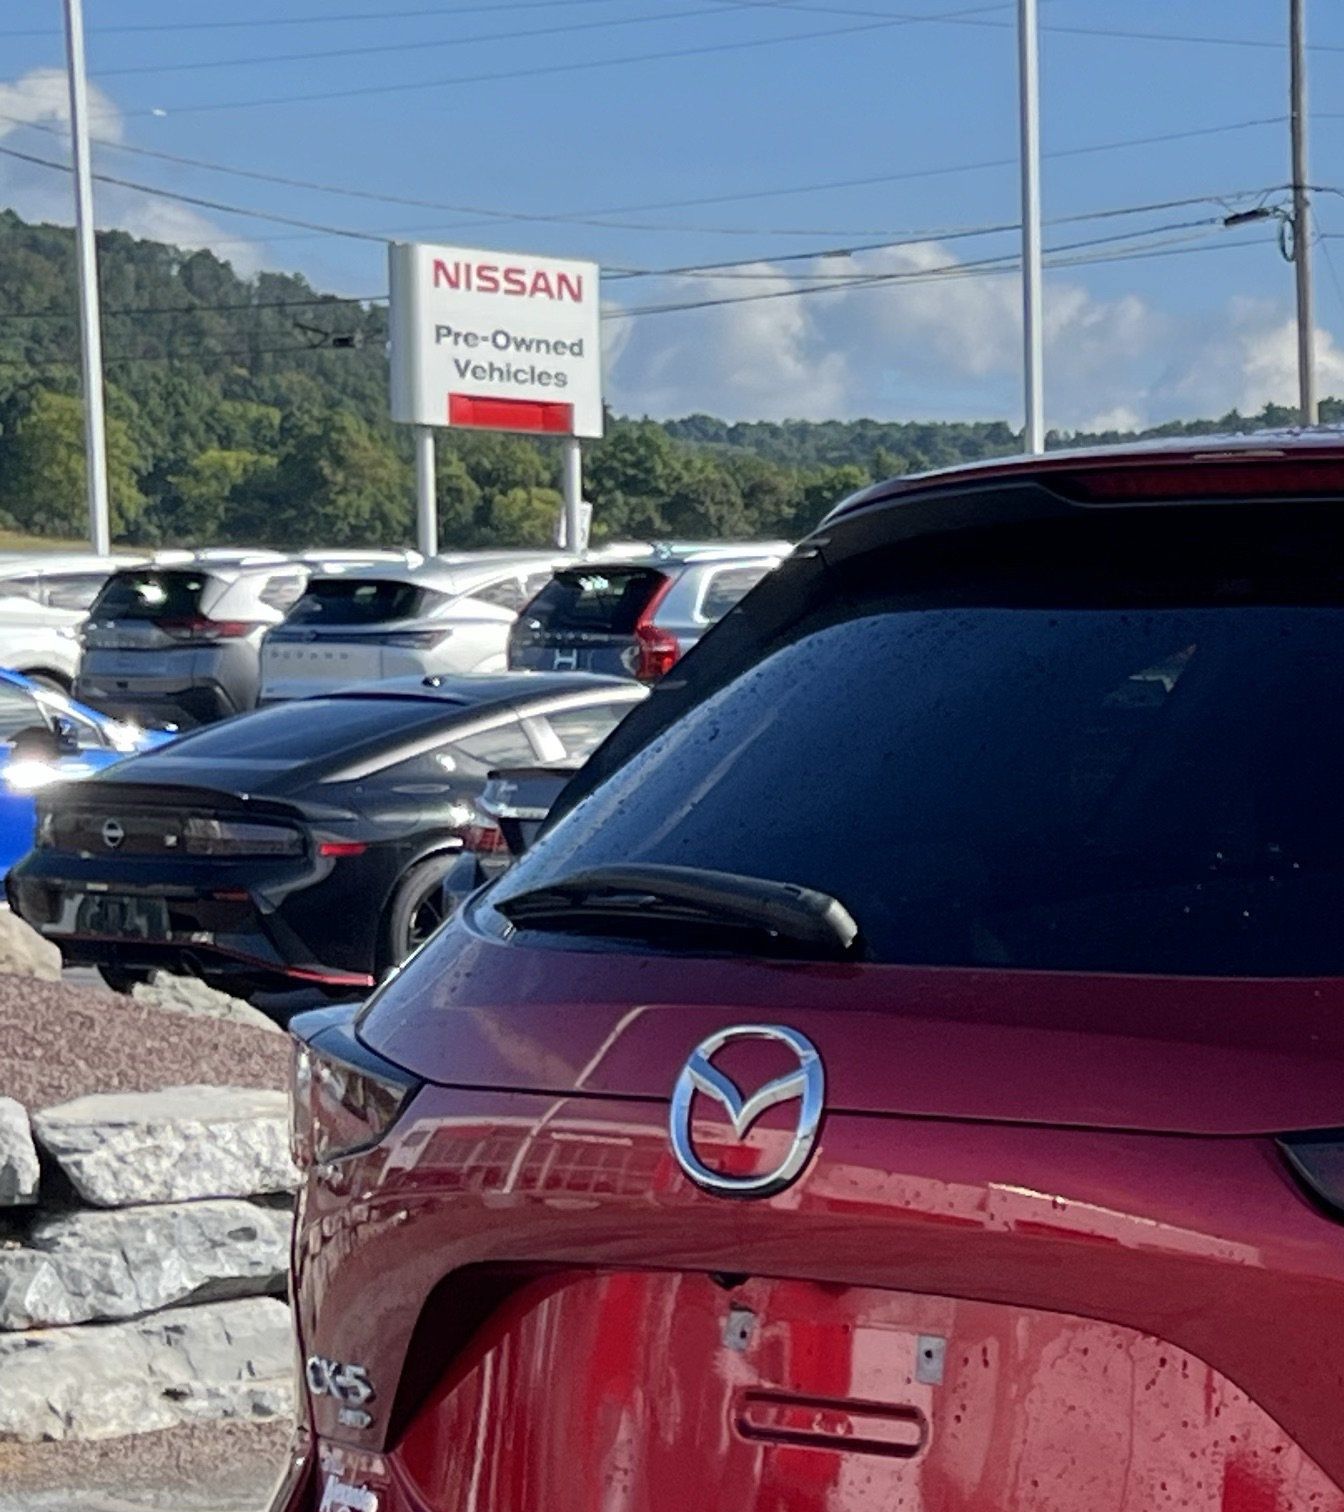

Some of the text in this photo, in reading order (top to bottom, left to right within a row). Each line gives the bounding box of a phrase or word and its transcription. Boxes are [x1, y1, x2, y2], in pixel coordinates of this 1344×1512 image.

[433, 258, 584, 304] NISSAN
[434, 324, 585, 358] Pre-Owned
[453, 358, 569, 388] Vehicles
